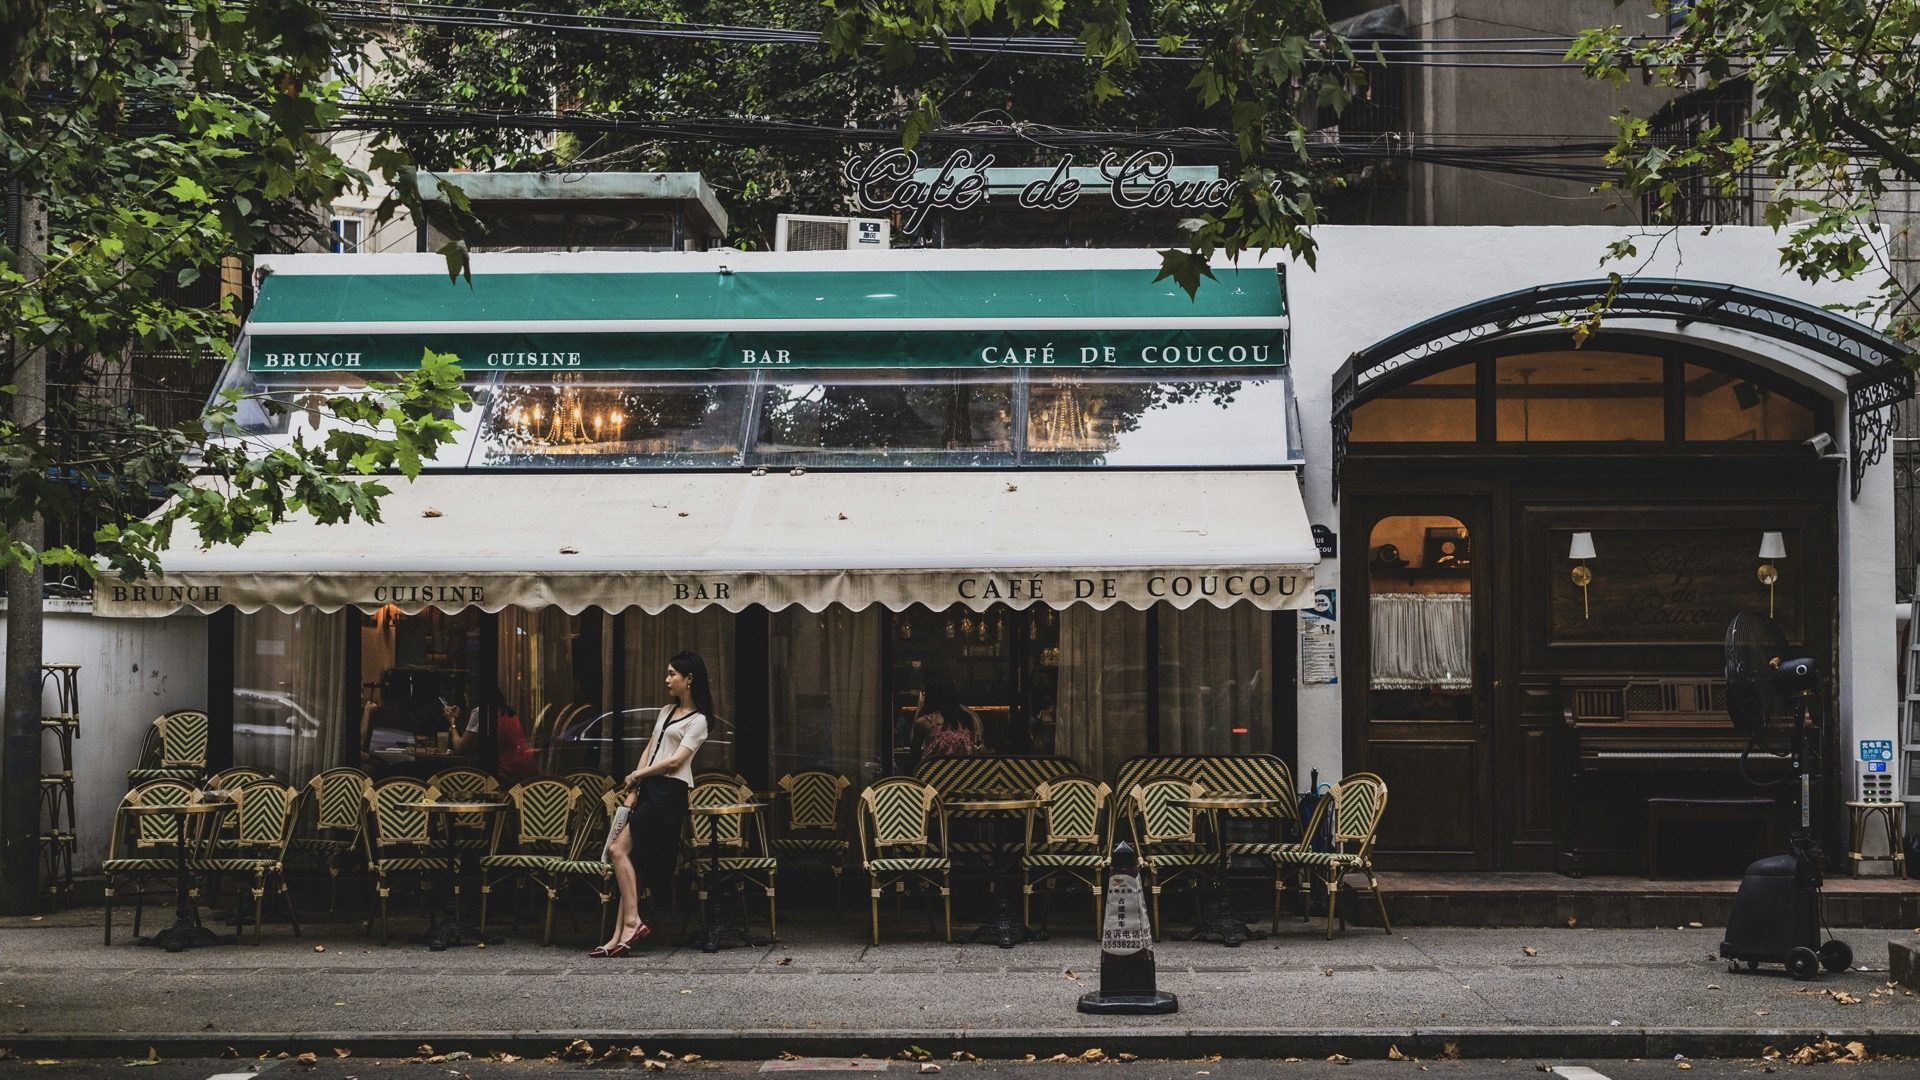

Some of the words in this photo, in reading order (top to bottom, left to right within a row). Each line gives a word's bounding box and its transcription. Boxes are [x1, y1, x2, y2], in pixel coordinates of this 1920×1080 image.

[845, 147, 995, 234] Café
[1018, 153, 1079, 209] de
[1099, 149, 1283, 208] Couc
[264, 353, 362, 368] BRUNCH
[487, 352, 582, 367] CUISINE
[741, 349, 791, 364] BAR
[981, 342, 1055, 365] CAFÉ
[1080, 347, 1117, 363] DE
[1141, 345, 1270, 364] COUCOU
[111, 585, 221, 602] BRUNCH
[373, 585, 486, 602] CUISINE
[674, 582, 731, 599] BAR
[957, 574, 1044, 599] CAFÉ
[1074, 578, 1117, 599] DE
[1146, 575, 1297, 596] COUCOU
[1104, 929, 1141, 939] 投诉电话
